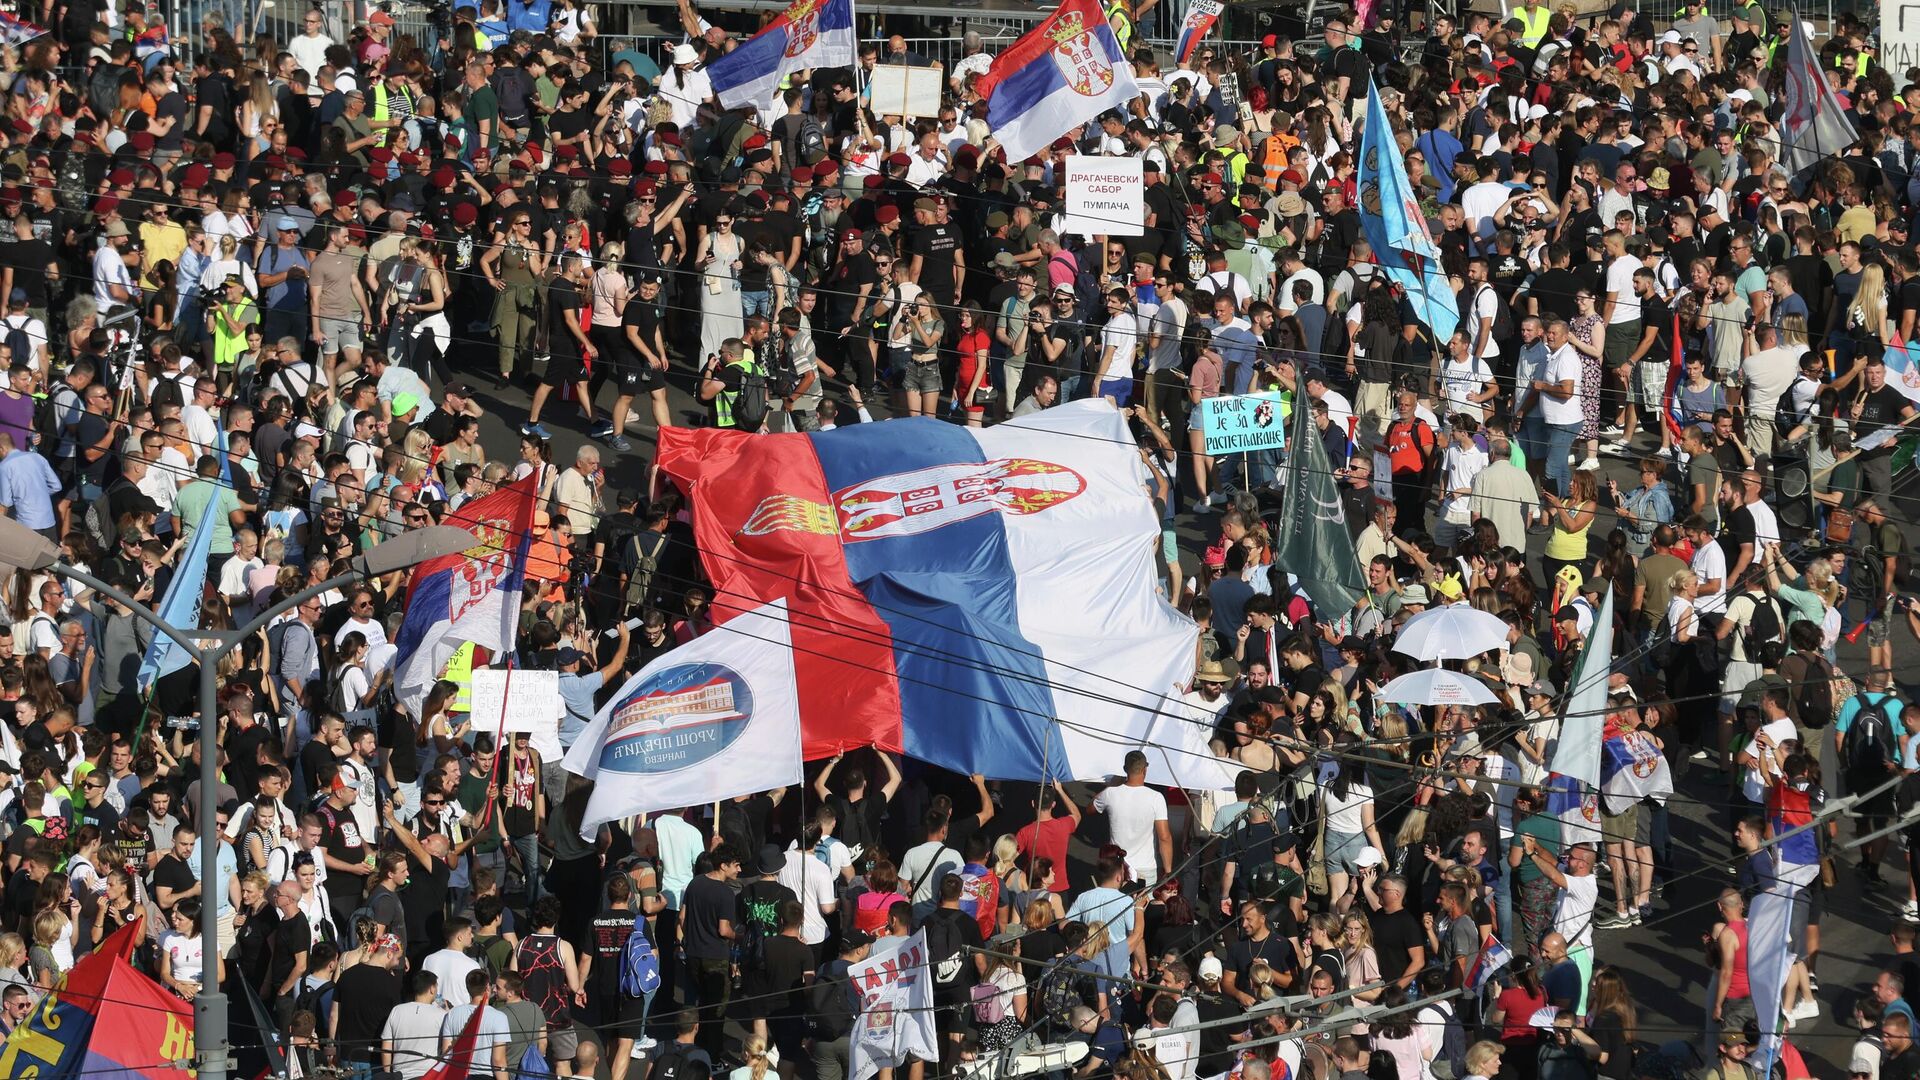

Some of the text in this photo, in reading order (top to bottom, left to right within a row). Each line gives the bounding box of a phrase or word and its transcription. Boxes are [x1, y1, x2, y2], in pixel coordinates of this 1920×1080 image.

[1070, 173, 1139, 184] ДРАГАЧЕВСКИ
[1088, 185, 1122, 193] САБОР
[1083, 200, 1130, 210] ПУМПАЧА
[1212, 398, 1246, 415] ВРЕМЕ
[1216, 413, 1248, 431] ЈЕ ЗА
[1206, 430, 1282, 451] РАСПЕТЉАВАЊЕ
[496, 683, 537, 694] VLETI
[938, 952, 961, 977] NIKE
